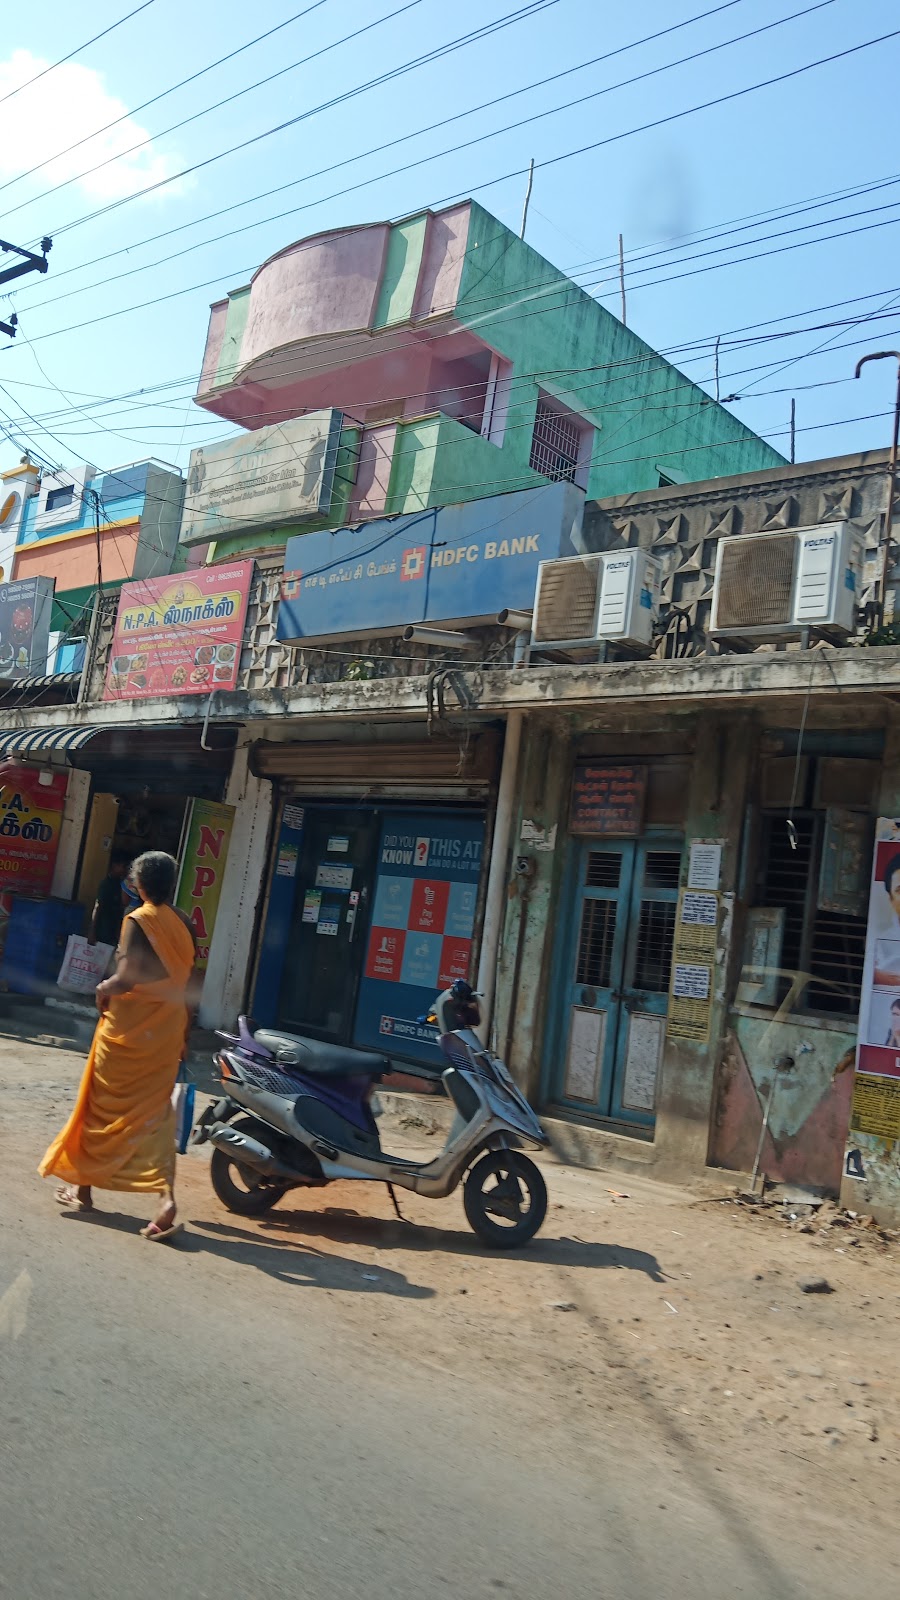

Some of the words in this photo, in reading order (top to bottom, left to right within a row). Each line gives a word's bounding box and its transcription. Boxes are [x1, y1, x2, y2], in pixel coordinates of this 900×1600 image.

[431, 544, 479, 568] HDFC
[484, 533, 540, 560] BANK
[123, 611, 159, 631] N.P.A.
[163, 596, 235, 627] ஸ்நாக்ஸ்
[383, 835, 397, 847] DID
[399, 836, 415, 848] YOU
[431, 838, 461, 857] THIS
[381, 849, 413, 865] KNOW
[393, 1023, 416, 1034] HDFC
